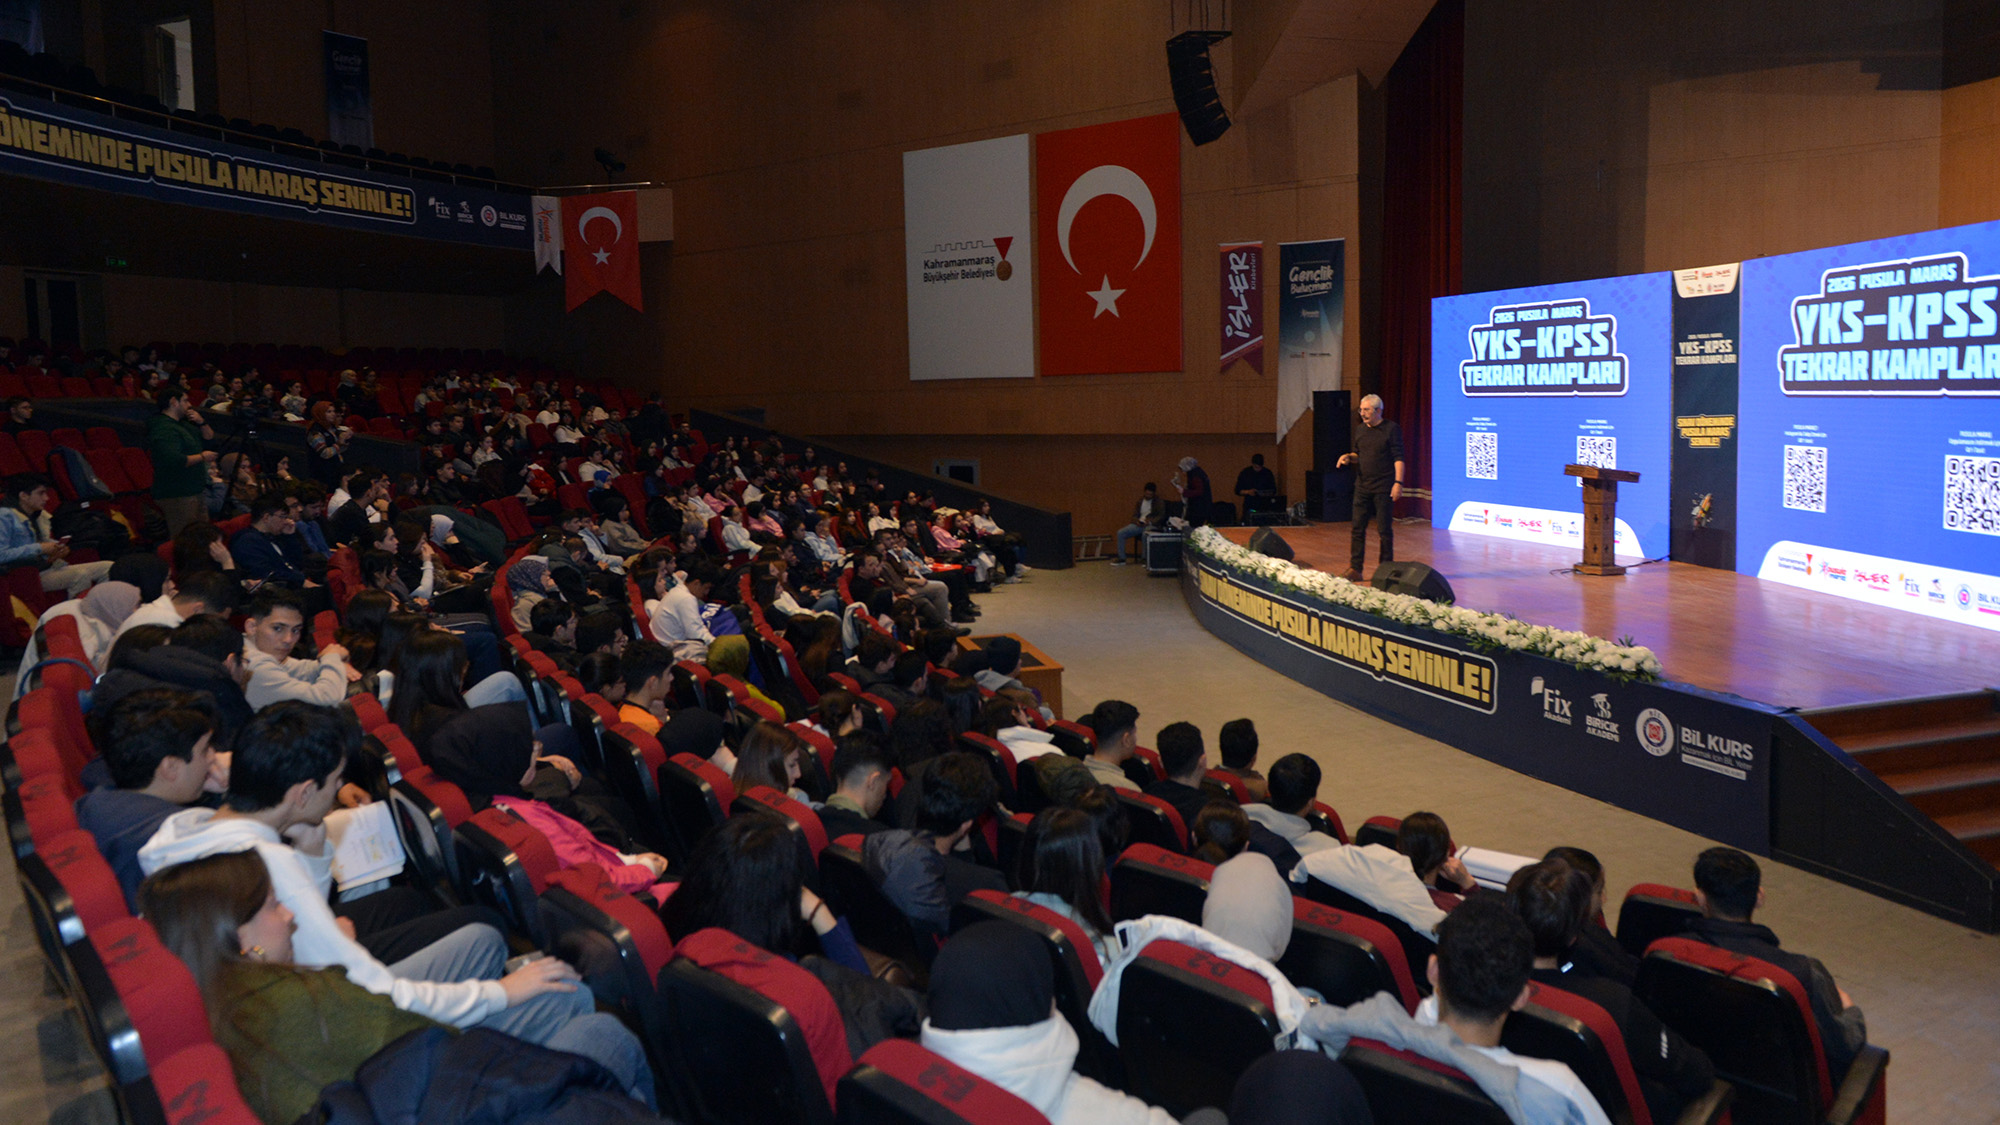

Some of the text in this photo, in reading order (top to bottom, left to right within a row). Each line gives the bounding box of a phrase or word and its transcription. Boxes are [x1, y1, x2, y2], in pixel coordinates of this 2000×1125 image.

[136, 145, 233, 189] PUSULA
[237, 165, 318, 204] MARAŞ
[435, 201, 450, 215] Fix
[923, 256, 995, 269] Kahramanmaraş
[923, 267, 995, 284] Büyükşehir Belediyesi
[1289, 265, 1334, 283] Gençlik
[1859, 269, 1906, 290] PUSULA
[1909, 263, 1958, 284] MARAŞ
[1516, 308, 1549, 322] PUSULA
[1551, 305, 1583, 320] MARAŞ
[1796, 286, 1999, 346] YKS-KPSS
[1472, 322, 1610, 362] YKS-KPSS
[1463, 361, 1621, 387] TEKRAR KAMPLARI
[1782, 350, 1870, 382] TEKRAR
[1904, 577, 1920, 593] Fix
[1271, 601, 1321, 647] PUSULA
[1321, 620, 1384, 671] MARAŞ
[1544, 687, 1572, 717] Fix
[1707, 733, 1753, 761] KURS
